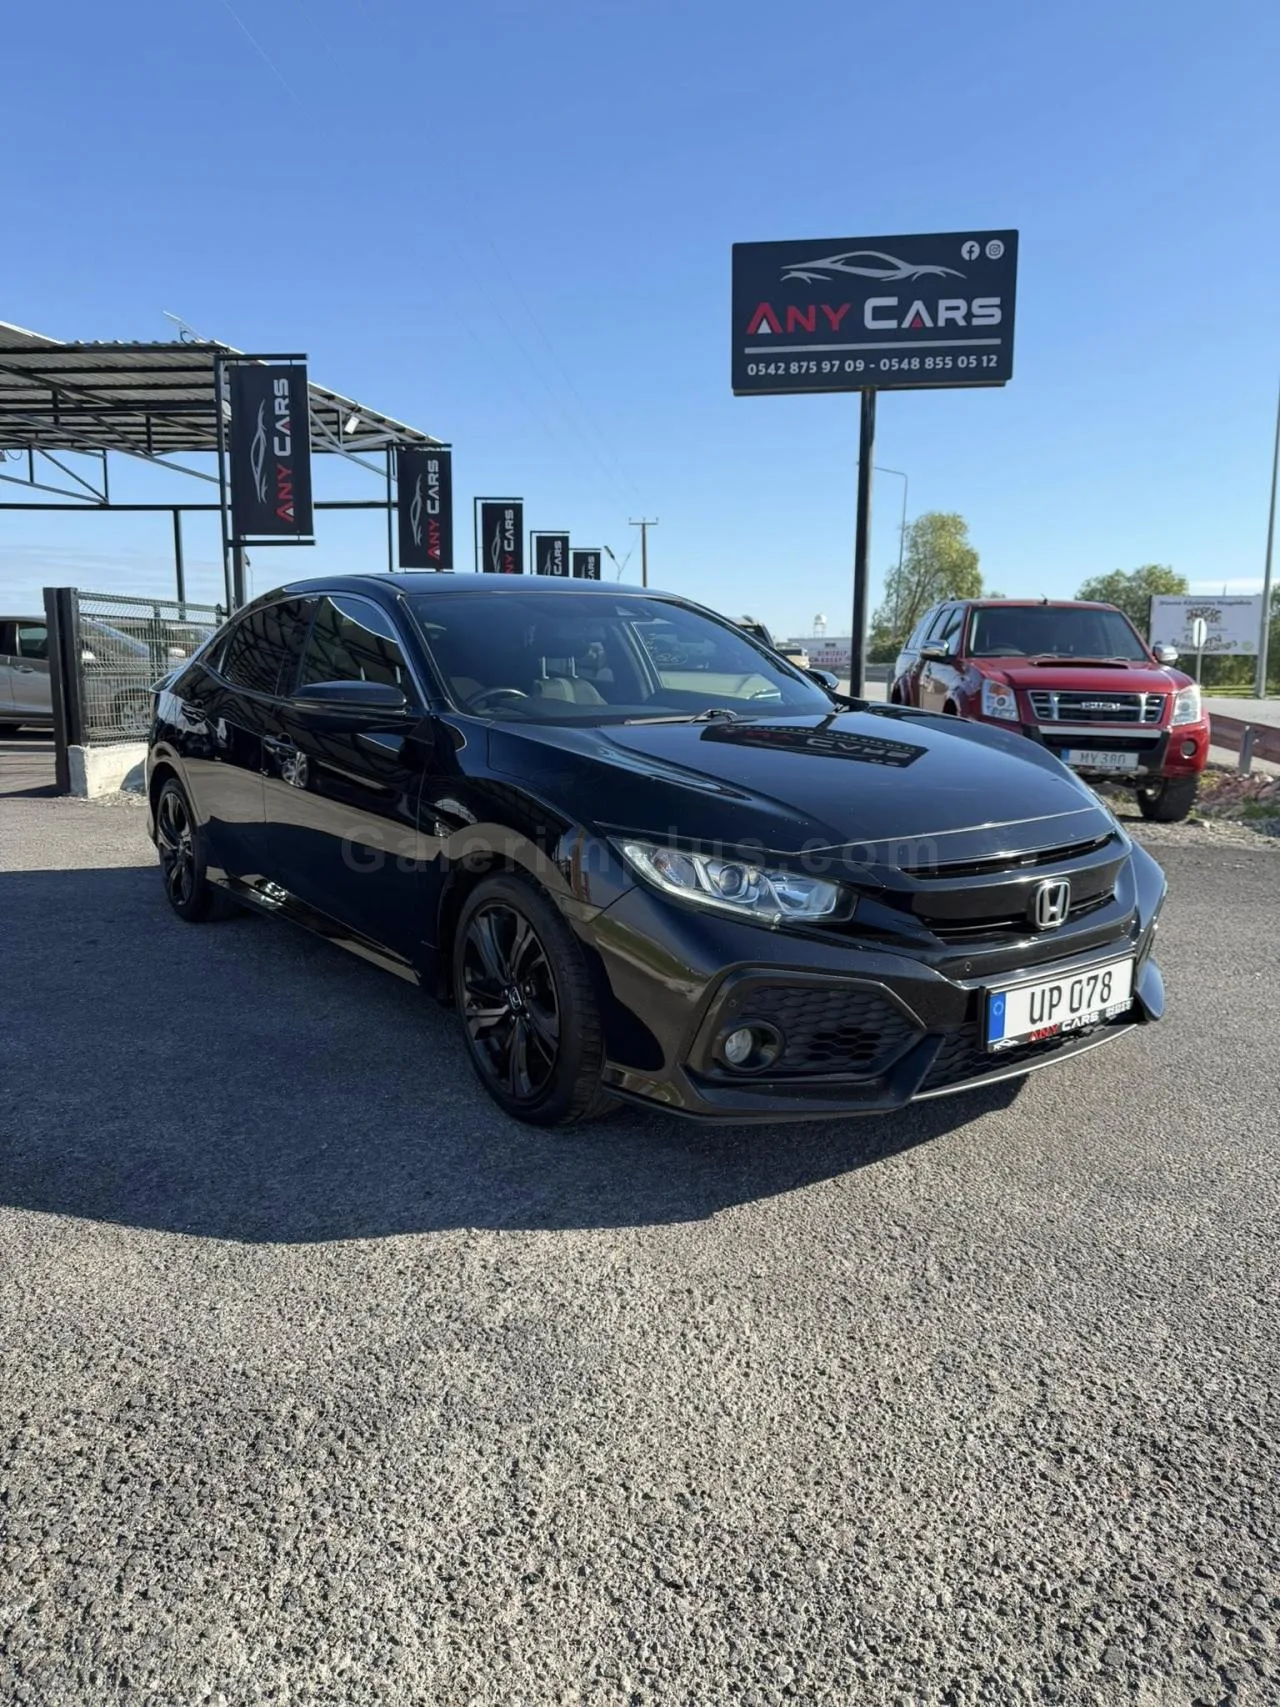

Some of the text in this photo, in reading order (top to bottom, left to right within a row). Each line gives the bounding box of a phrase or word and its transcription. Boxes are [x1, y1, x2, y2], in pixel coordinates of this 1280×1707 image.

[746, 297, 1002, 334] ANY CARS
[747, 362, 785, 376] 0542
[789, 361, 817, 374] 875
[821, 360, 840, 373] 97
[845, 359, 865, 373] 09
[880, 357, 921, 371] 0548
[924, 356, 953, 370] 855
[957, 355, 977, 368] 05
[982, 355, 998, 368] 12
[273, 378, 295, 523] ANY CARS
[426, 459, 440, 560] ANY CARS
[504, 509, 514, 552] CARS
[553, 540, 562, 575] CARS
[1029, 985, 1062, 1025] UP
[1069, 971, 1113, 1013] 078
[1028, 1011, 1099, 1041] ANY CARS
